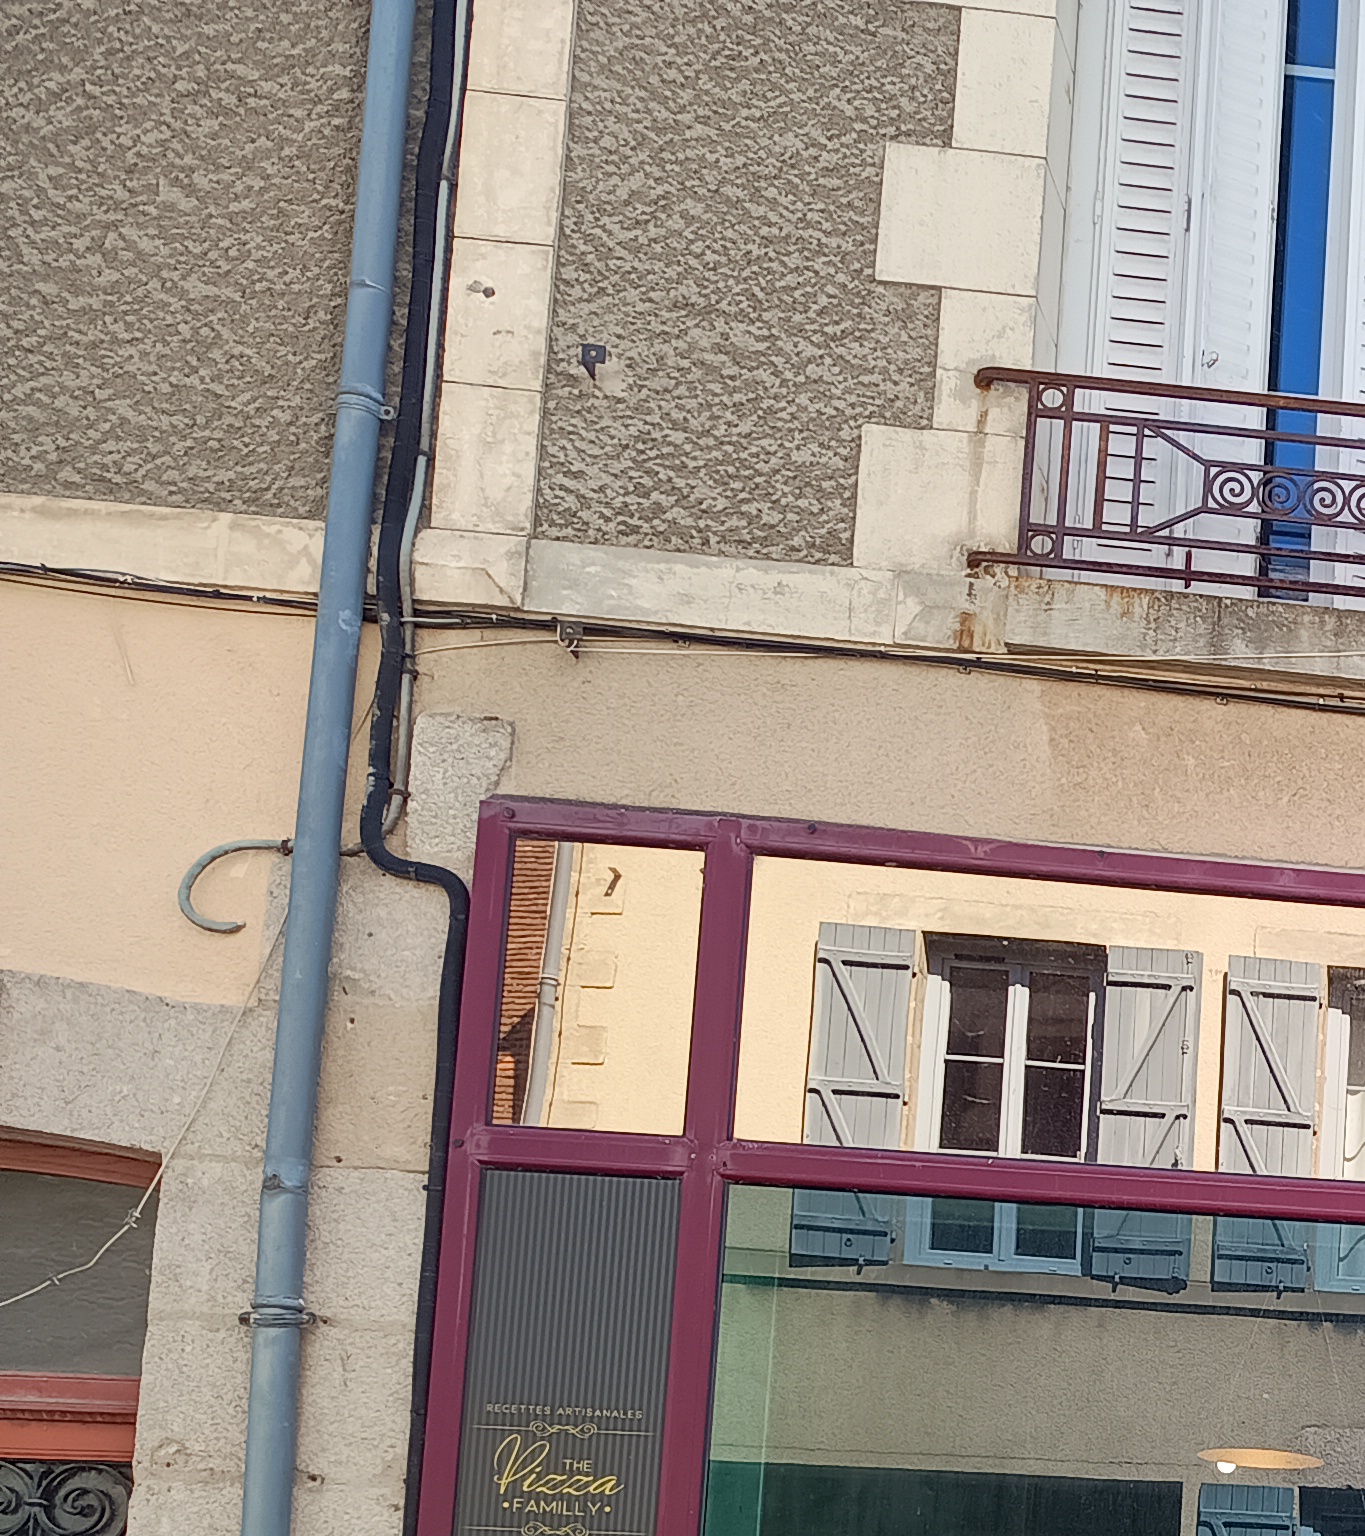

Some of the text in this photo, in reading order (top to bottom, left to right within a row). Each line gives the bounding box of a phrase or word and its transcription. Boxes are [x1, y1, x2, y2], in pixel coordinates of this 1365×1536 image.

[486, 1403, 643, 1419] RECETTES ARTISANALES
[494, 1433, 624, 1496] Pizza
[563, 1459, 592, 1472] THE
